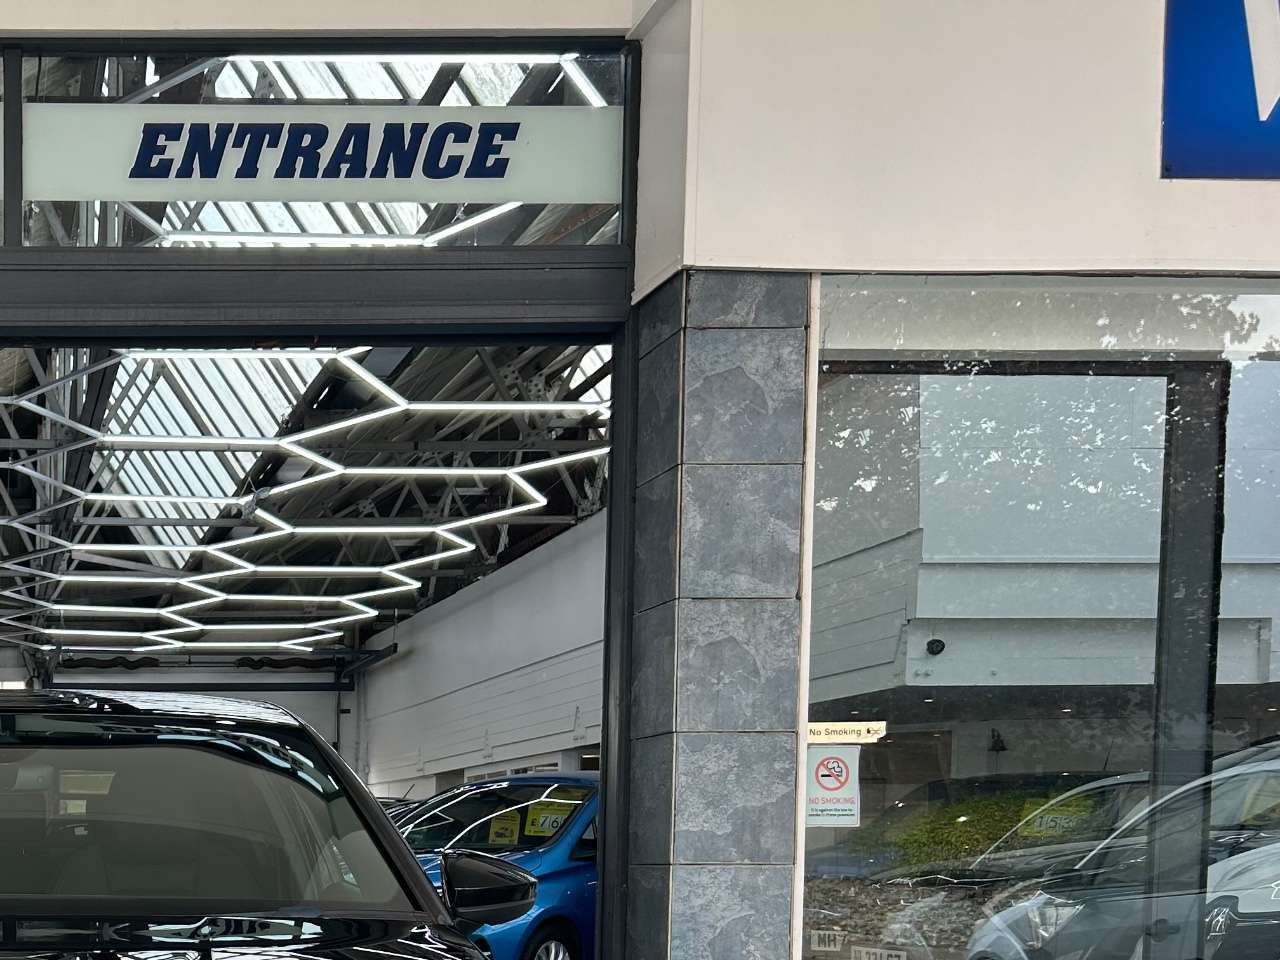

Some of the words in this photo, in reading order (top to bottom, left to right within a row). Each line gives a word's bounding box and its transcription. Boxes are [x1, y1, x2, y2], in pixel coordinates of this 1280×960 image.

[128, 122, 520, 179] ENTRANCE
[809, 728, 822, 736] No
[824, 727, 861, 738] Smoking
